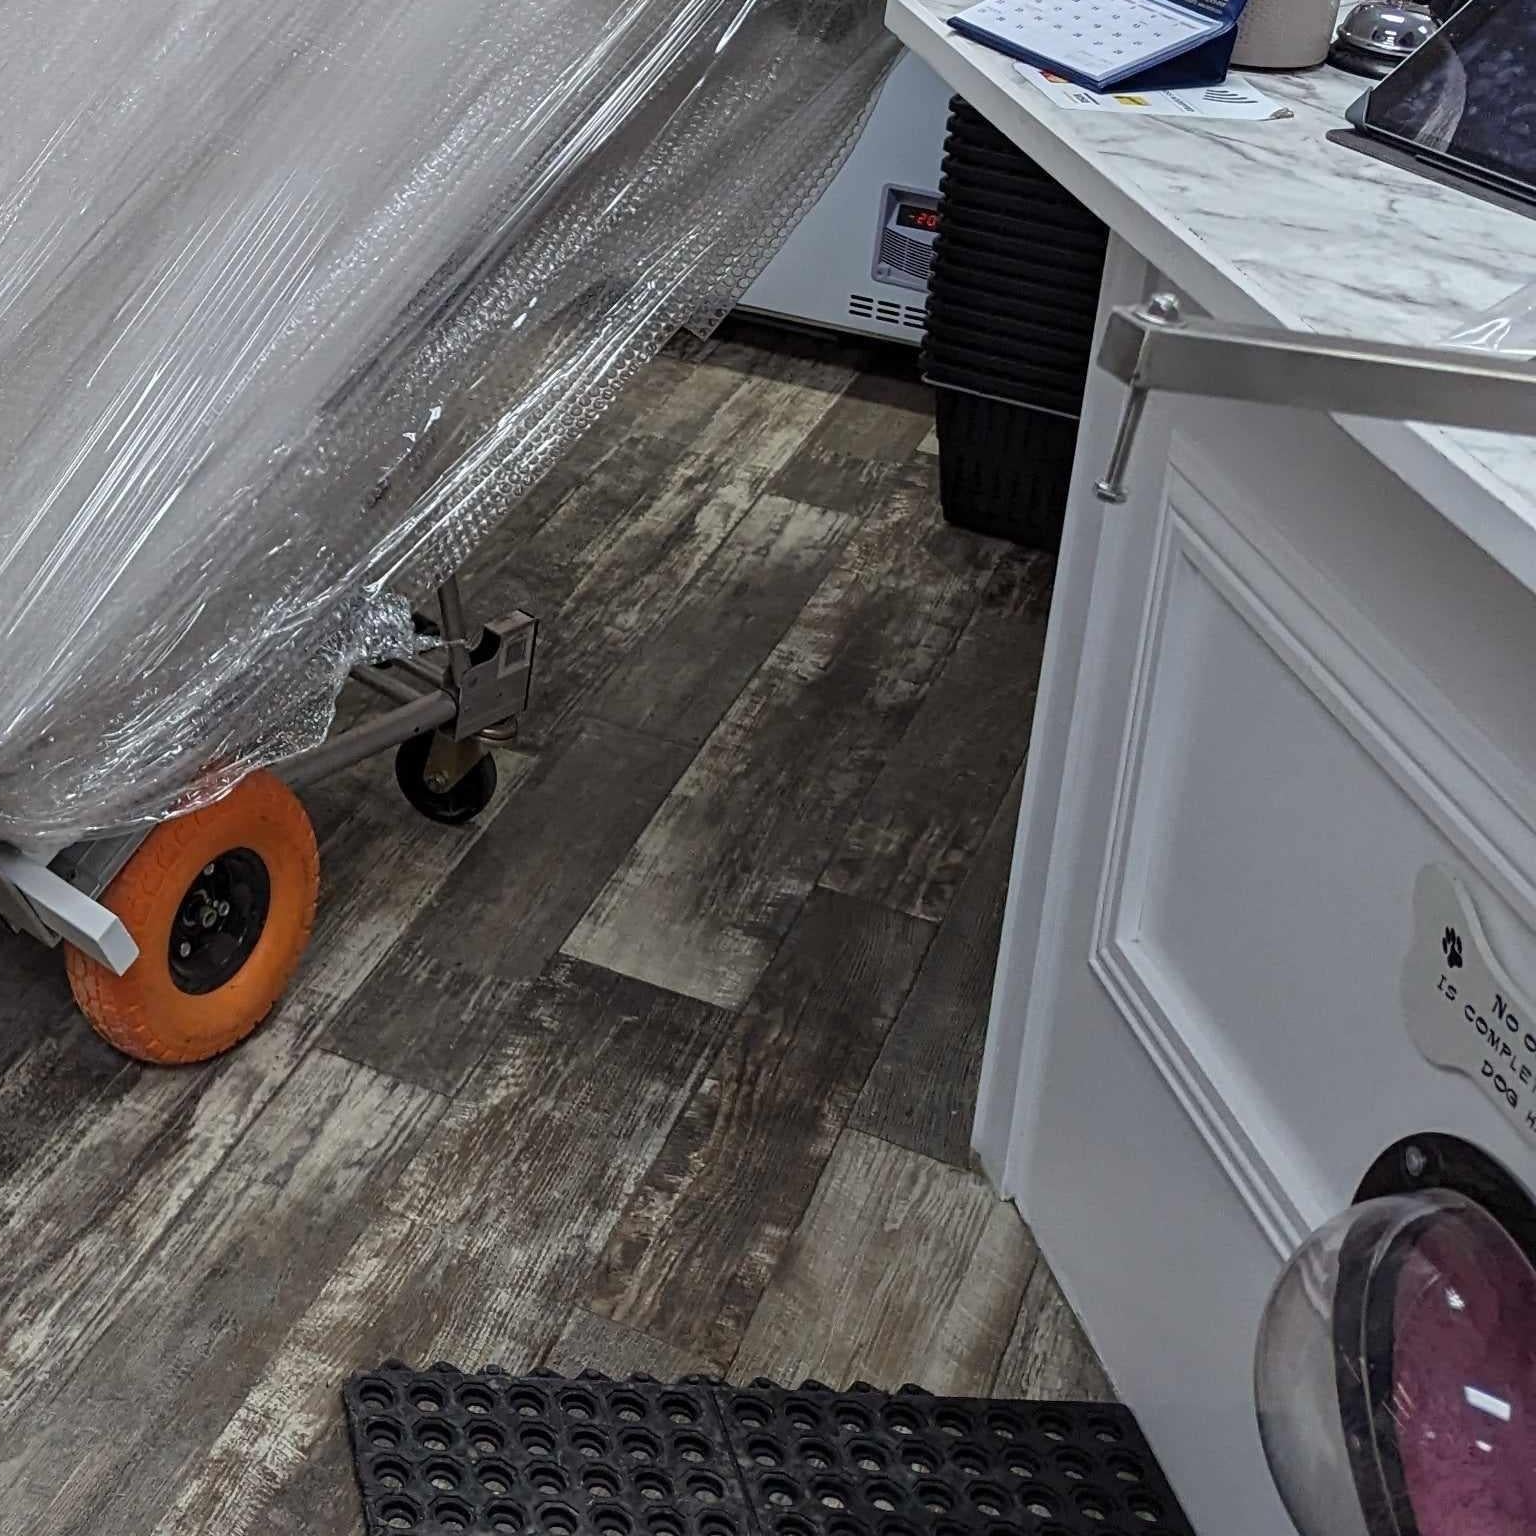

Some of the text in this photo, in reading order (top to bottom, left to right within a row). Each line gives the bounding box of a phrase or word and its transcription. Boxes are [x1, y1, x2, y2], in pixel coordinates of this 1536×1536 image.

[1437, 974, 1536, 1094] IS COMPLE
[1492, 993, 1519, 1033] NO
[1481, 1059, 1518, 1110] DOG
